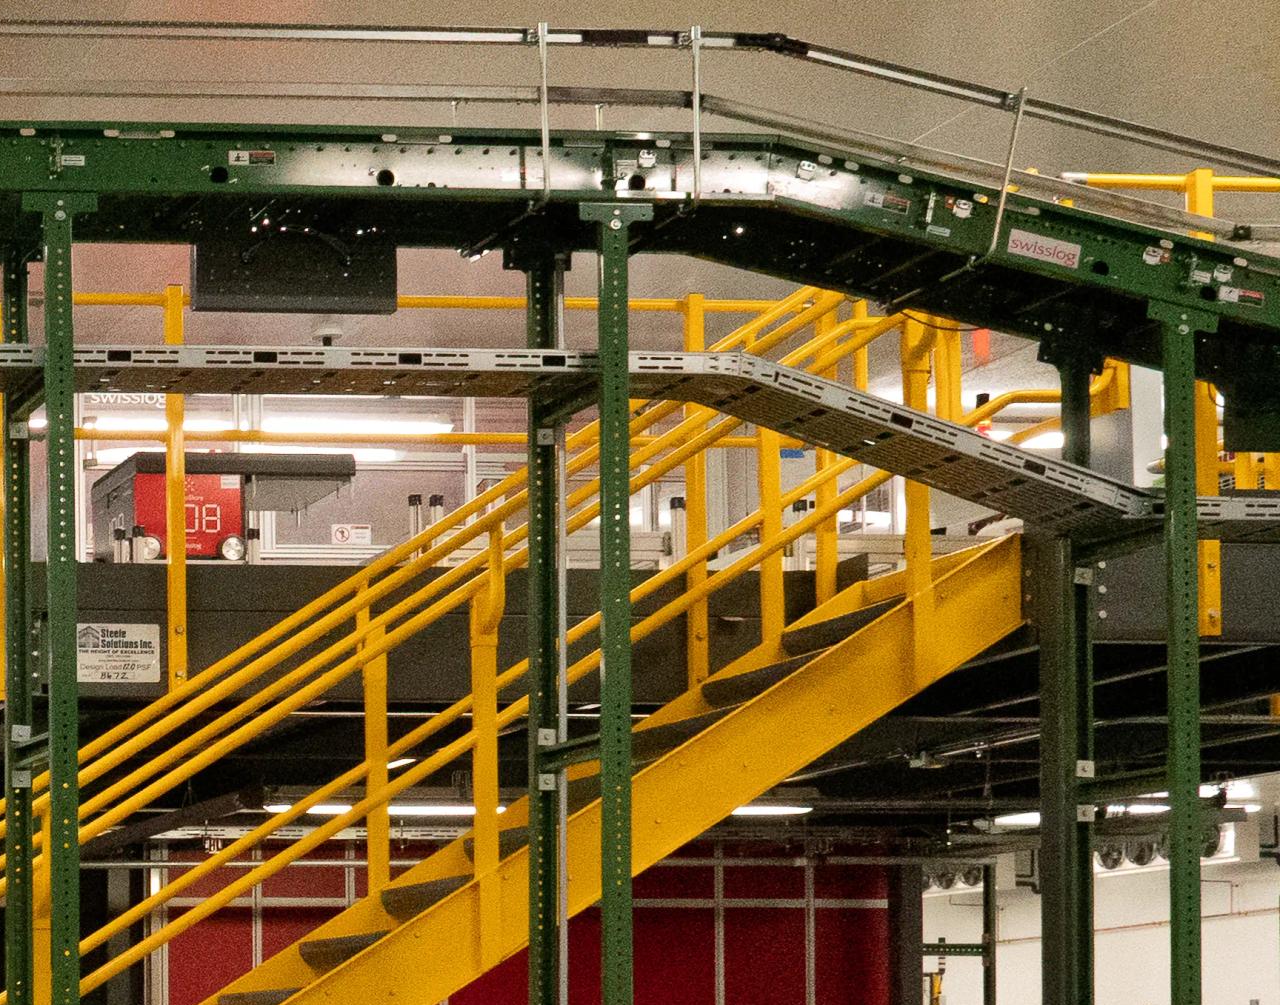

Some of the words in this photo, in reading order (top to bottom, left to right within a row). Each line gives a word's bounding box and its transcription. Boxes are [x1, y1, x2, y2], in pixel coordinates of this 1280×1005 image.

[1011, 238, 1077, 267] swisslog
[90, 393, 167, 409] swisslog
[100, 628, 127, 638] Steele
[100, 639, 138, 649] Solutions
[140, 639, 155, 649] Inc.
[80, 663, 104, 672] Design
